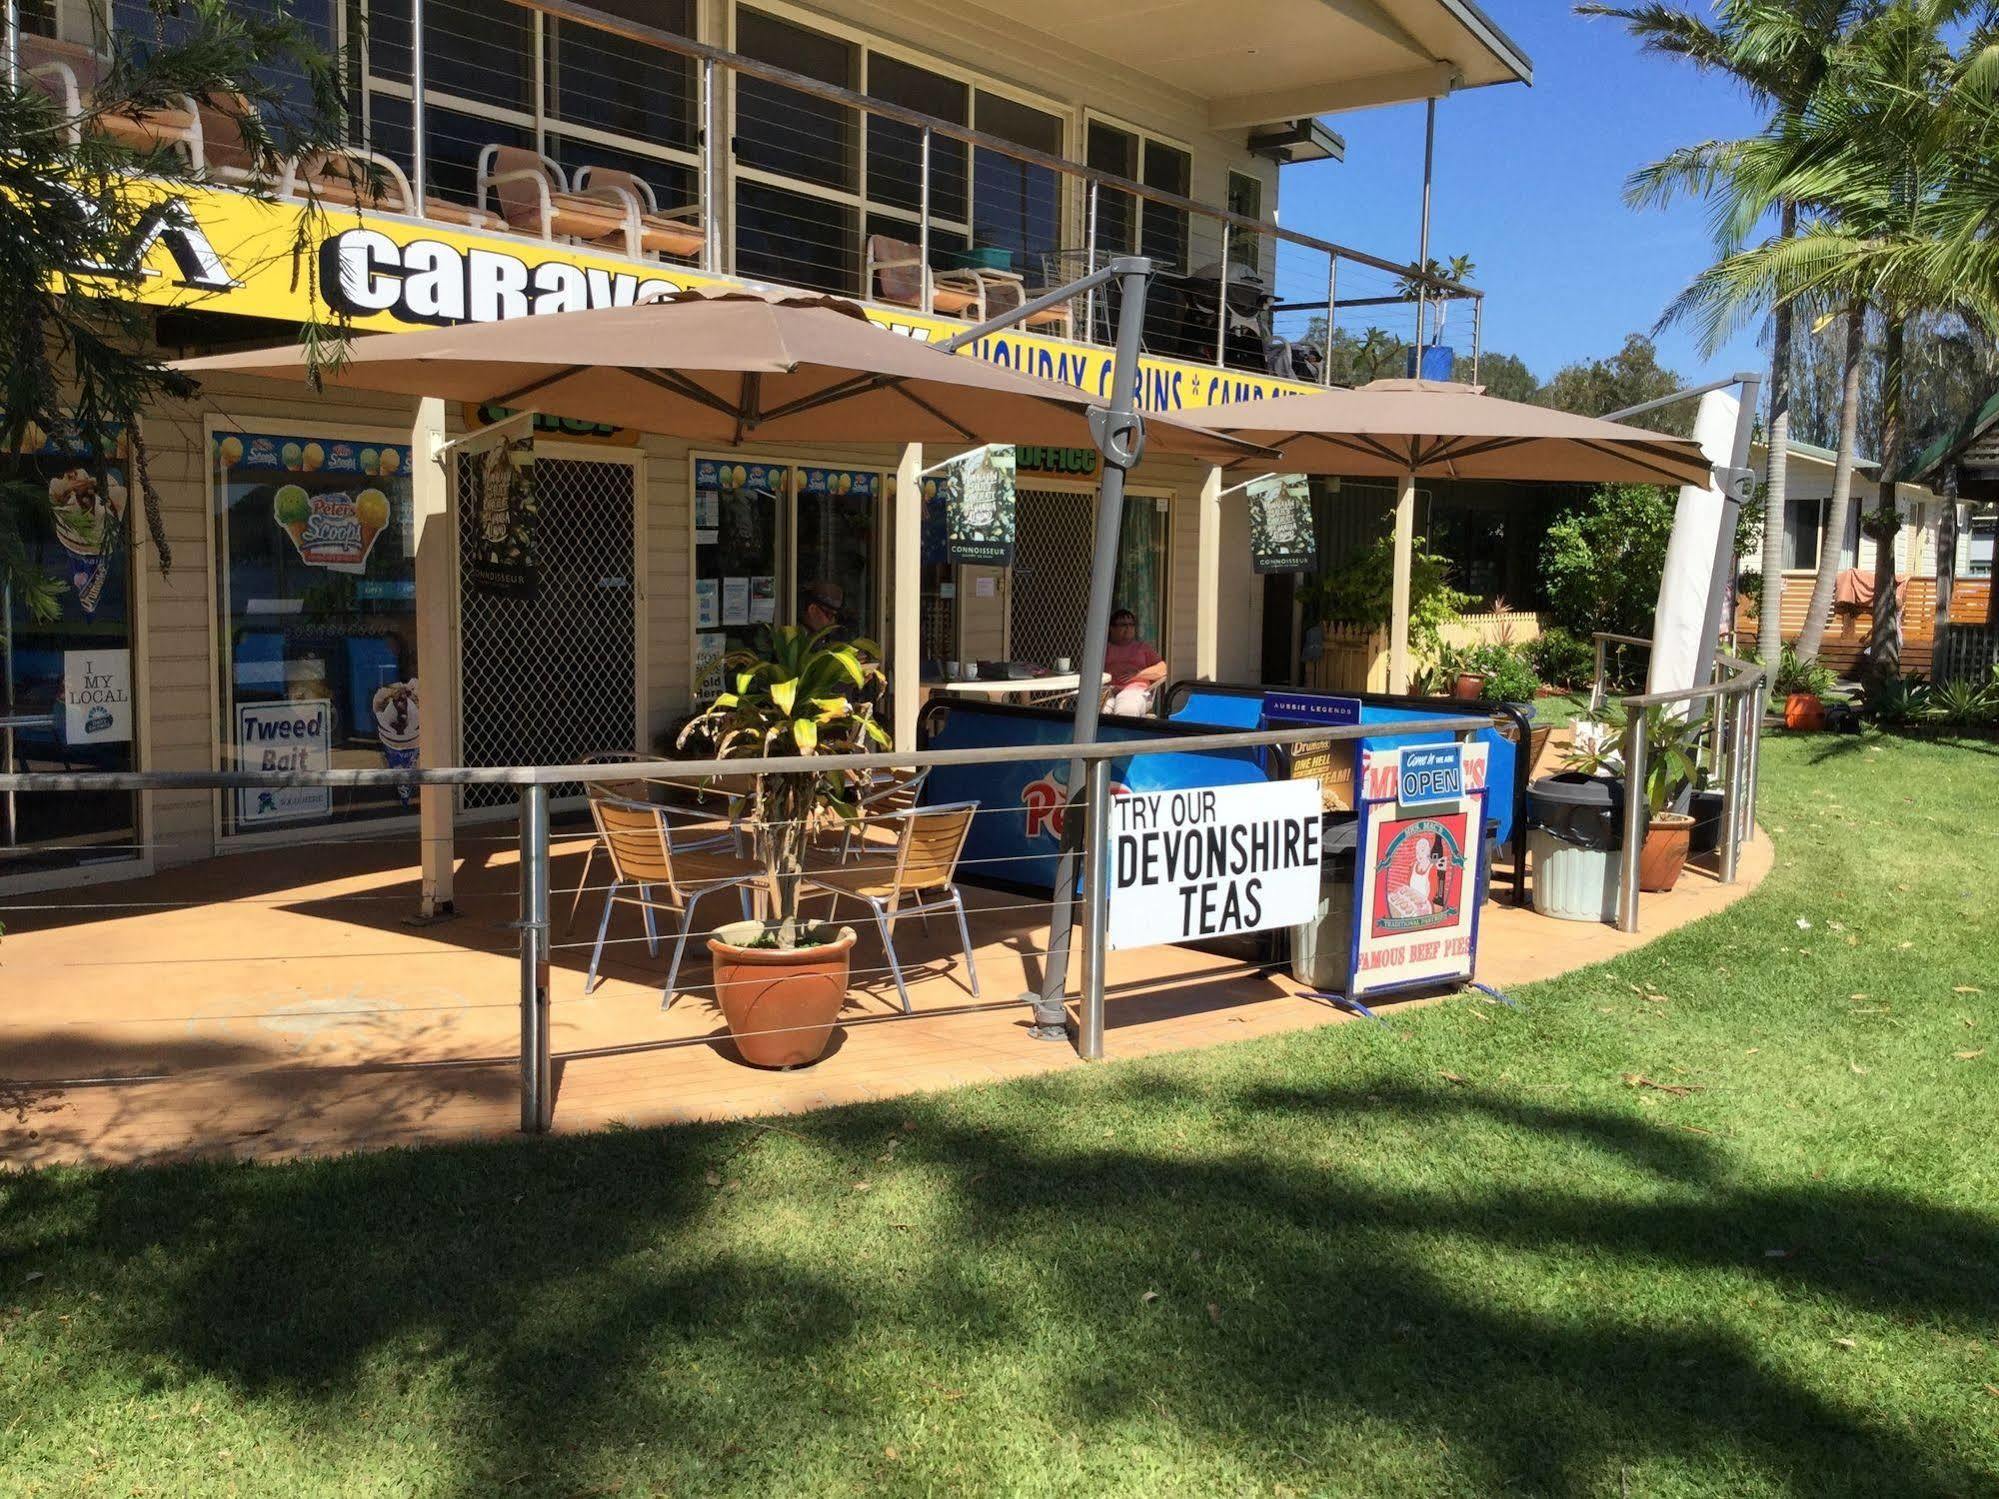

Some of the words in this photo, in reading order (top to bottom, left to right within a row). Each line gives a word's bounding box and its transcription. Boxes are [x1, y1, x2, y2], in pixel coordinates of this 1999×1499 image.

[322, 228, 690, 324] CaRaV
[1099, 359, 1182, 412] CBINS
[302, 514, 362, 551] Scoops
[951, 545, 1005, 556] CONNOISSEUR
[473, 569, 525, 584] ONNOISSEUR
[84, 675, 113, 689] MY
[703, 676, 721, 687] old
[70, 689, 128, 705] LOCAL
[1273, 702, 1306, 712] AUSSIE
[1310, 705, 1352, 715] LEGENDS
[244, 711, 323, 741] Tweed
[262, 747, 309, 771] Bait
[1294, 757, 1311, 771] ONE
[1312, 754, 1331, 767] HELL
[1402, 768, 1459, 798] OPEN
[1115, 793, 1162, 831] TRY
[1171, 790, 1217, 826] OUR
[1117, 816, 1319, 889] DEVONSHIRE
[1179, 877, 1263, 937] TEAS
[1358, 944, 1406, 971] FAMOUS
[1409, 940, 1441, 963] BEEF
[1443, 935, 1472, 958] PIES
